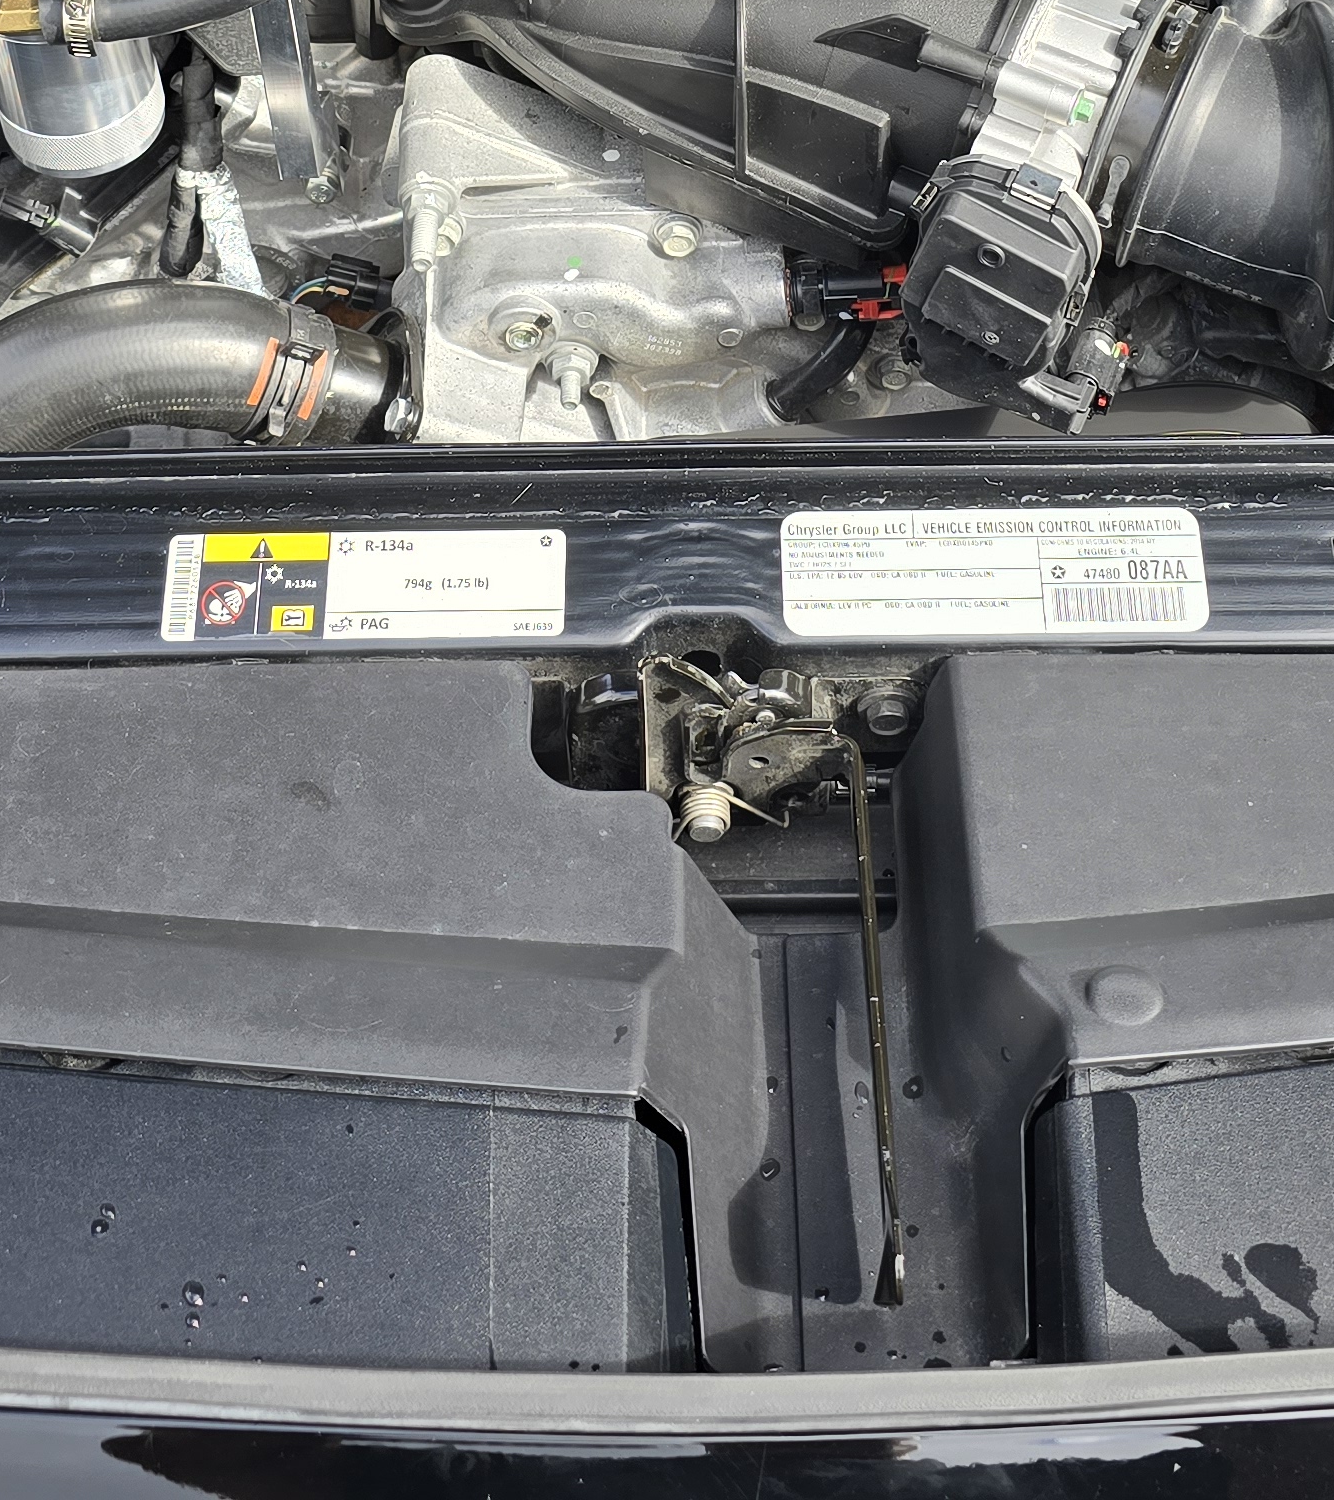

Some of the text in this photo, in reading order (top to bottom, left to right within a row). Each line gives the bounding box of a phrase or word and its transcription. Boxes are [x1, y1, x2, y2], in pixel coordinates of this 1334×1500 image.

[787, 522, 907, 538] Chrysler Group LLC
[921, 519, 1182, 534] VEHICLE EMISSION CONTROL INFORMATION
[365, 539, 414, 552] R-134a
[1077, 548, 1141, 556] ENGINE: 6.4L
[1083, 559, 1189, 580] 47480 087AA
[284, 579, 317, 589] R-134a
[404, 577, 490, 591] 794g (1.75 lb)
[360, 617, 390, 630] PAG
[513, 622, 553, 631] SAE J639
